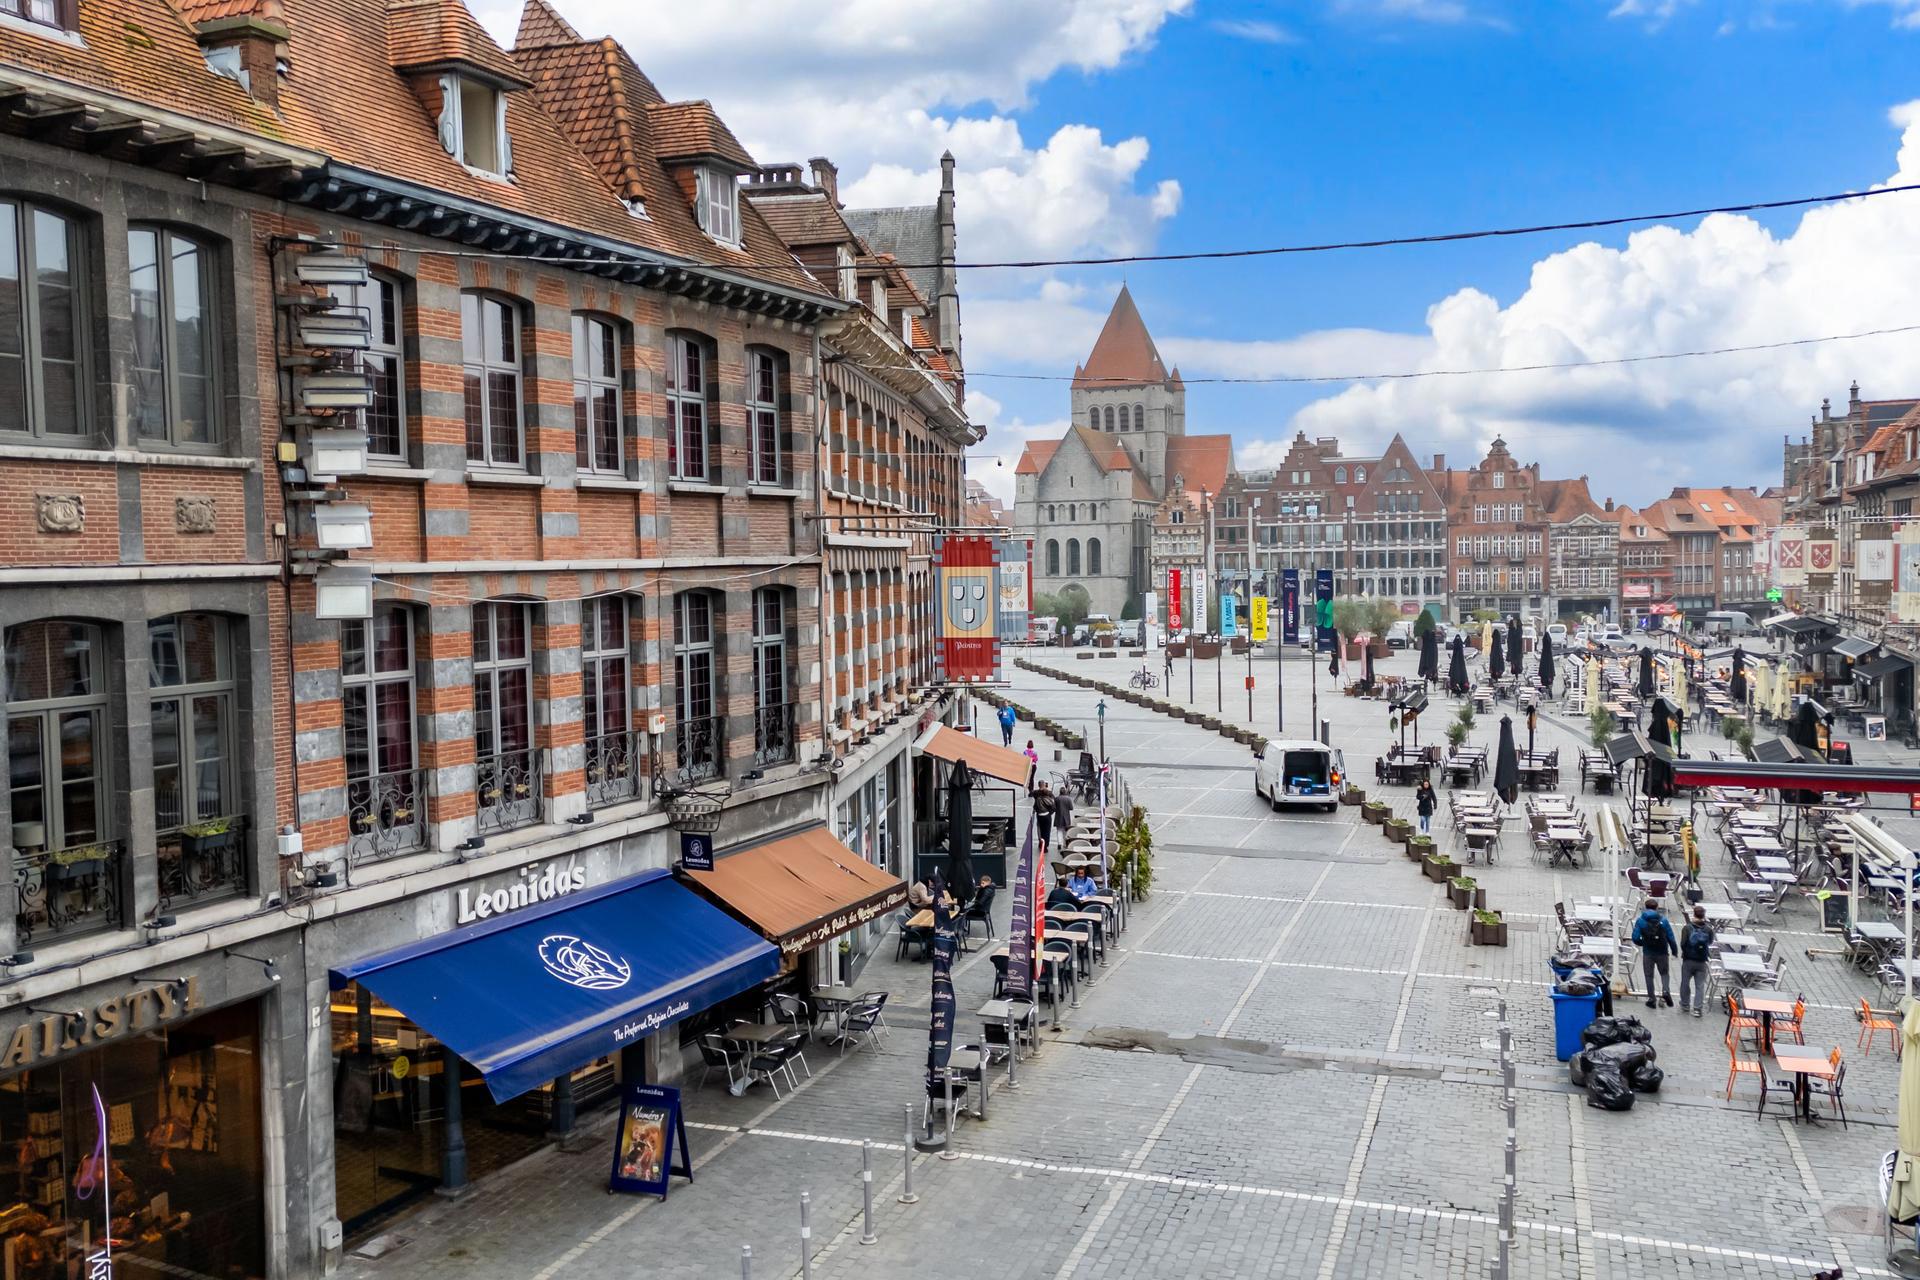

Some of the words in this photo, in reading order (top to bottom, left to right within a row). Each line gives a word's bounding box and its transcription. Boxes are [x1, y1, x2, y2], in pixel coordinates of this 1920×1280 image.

[457, 853, 585, 924] Leonidas
[613, 1028, 624, 1042] The
[624, 1019, 648, 1039] Preferred
[647, 1013, 667, 1029] Belgian
[636, 1087, 665, 1097] Leonidas
[631, 1106, 660, 1121] Numéro
